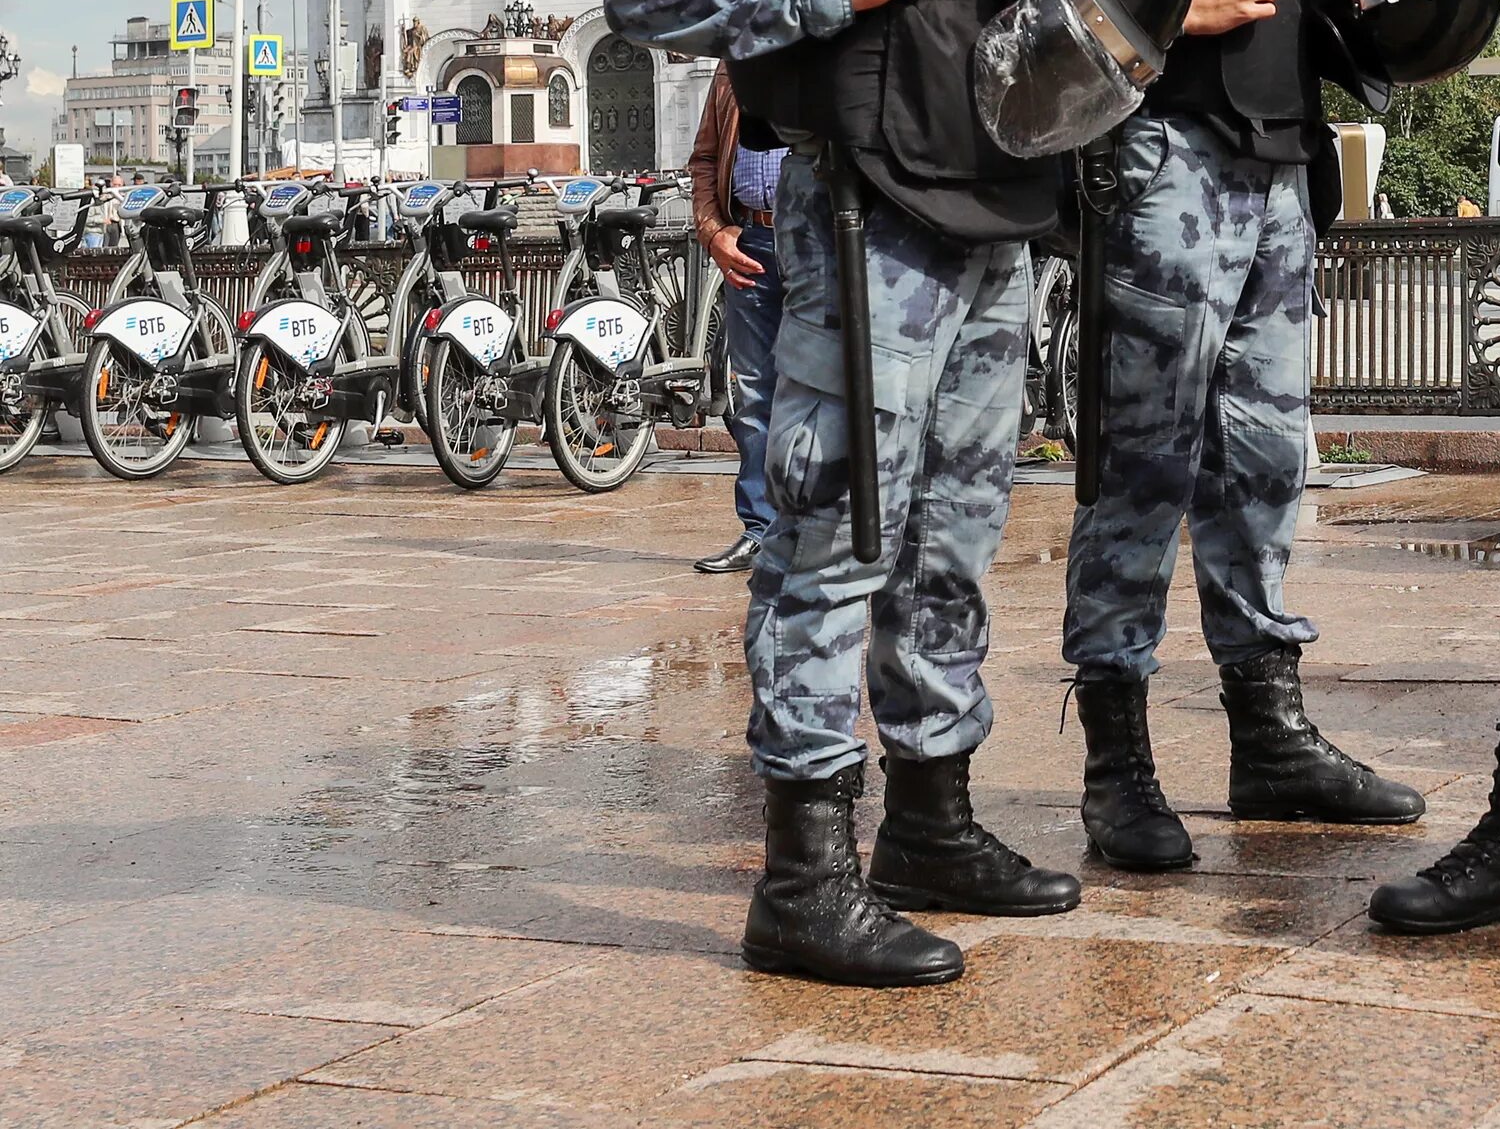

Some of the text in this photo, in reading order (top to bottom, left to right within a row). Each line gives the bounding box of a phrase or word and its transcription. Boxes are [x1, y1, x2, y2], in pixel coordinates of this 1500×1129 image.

[139, 316, 166, 336] ВТБ
[291, 318, 317, 338] ВТБ
[473, 316, 494, 337] ВТБ
[598, 317, 623, 338] ВТБ
